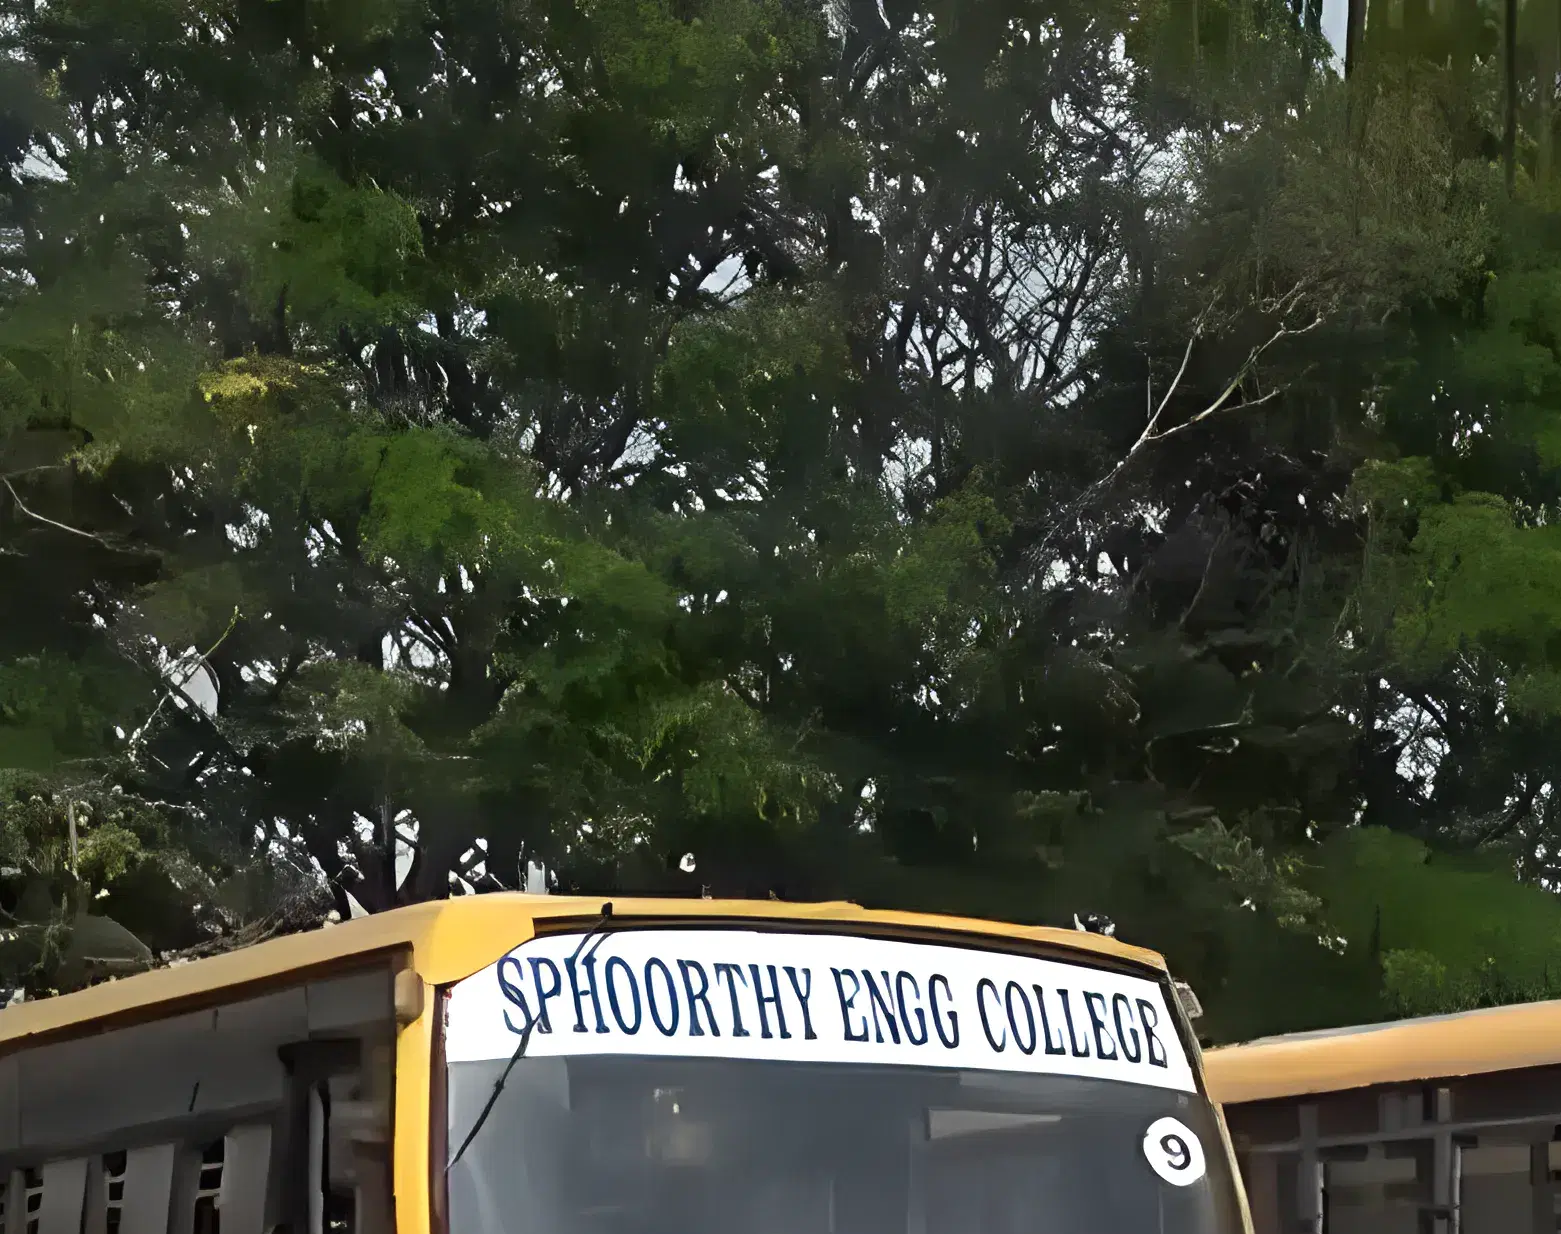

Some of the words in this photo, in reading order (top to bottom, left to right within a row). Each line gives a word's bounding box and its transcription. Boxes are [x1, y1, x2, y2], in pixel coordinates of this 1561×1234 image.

[497, 955, 818, 1041] SPHOORTHY
[830, 967, 960, 1050] ENGG
[977, 977, 1168, 1069] COLLEGE
[1159, 1133, 1192, 1171] 9
